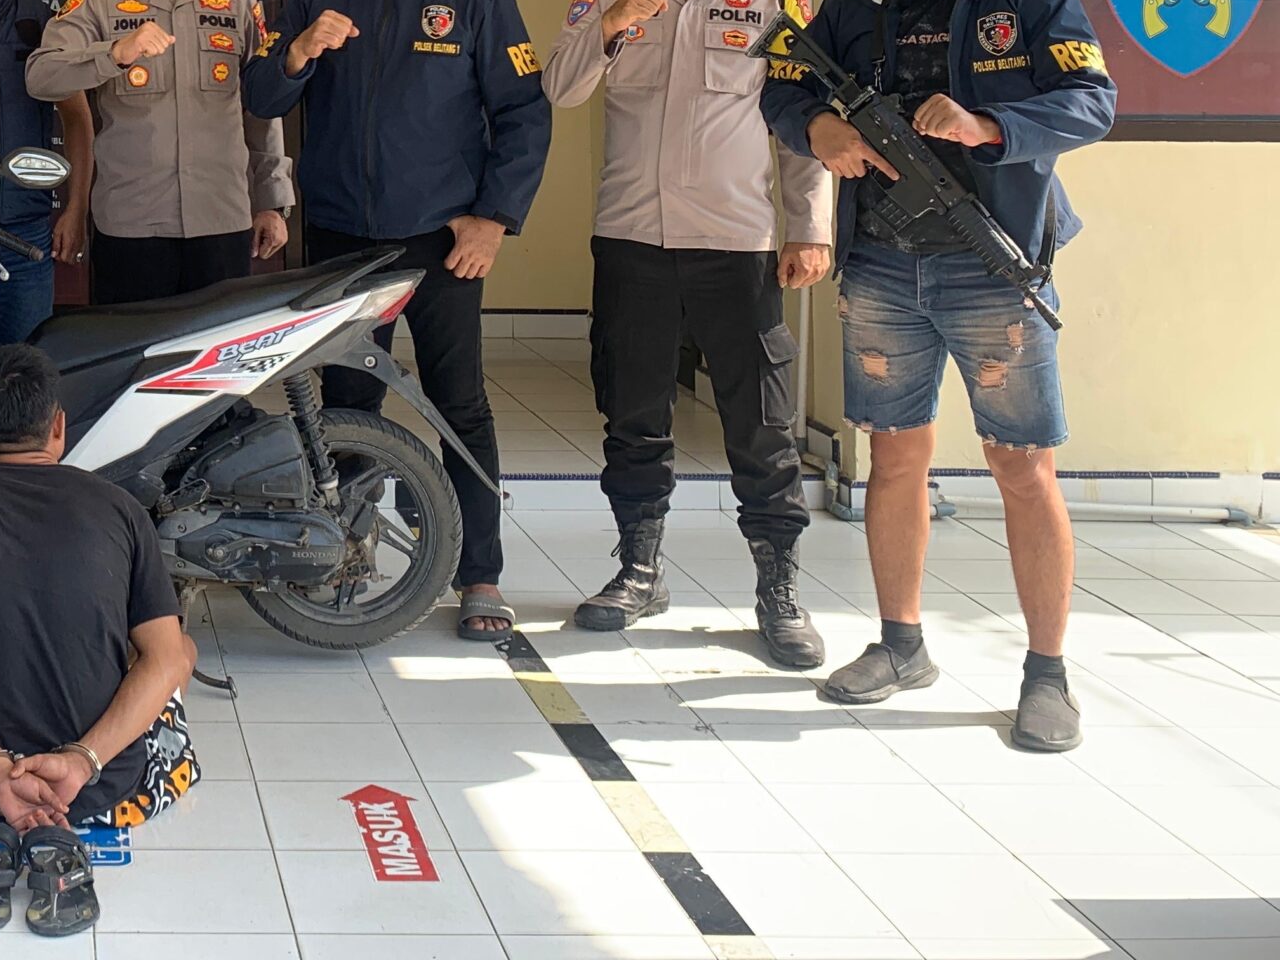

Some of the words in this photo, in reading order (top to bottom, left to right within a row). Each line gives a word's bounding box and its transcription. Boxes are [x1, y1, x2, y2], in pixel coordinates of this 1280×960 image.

[199, 14, 237, 29] POLRI
[709, 8, 763, 25] POLRI
[972, 59, 997, 73] POLSEK
[997, 55, 1026, 70] BELITANG
[291, 551, 337, 559] HONDA
[359, 800, 423, 876] MASUK
